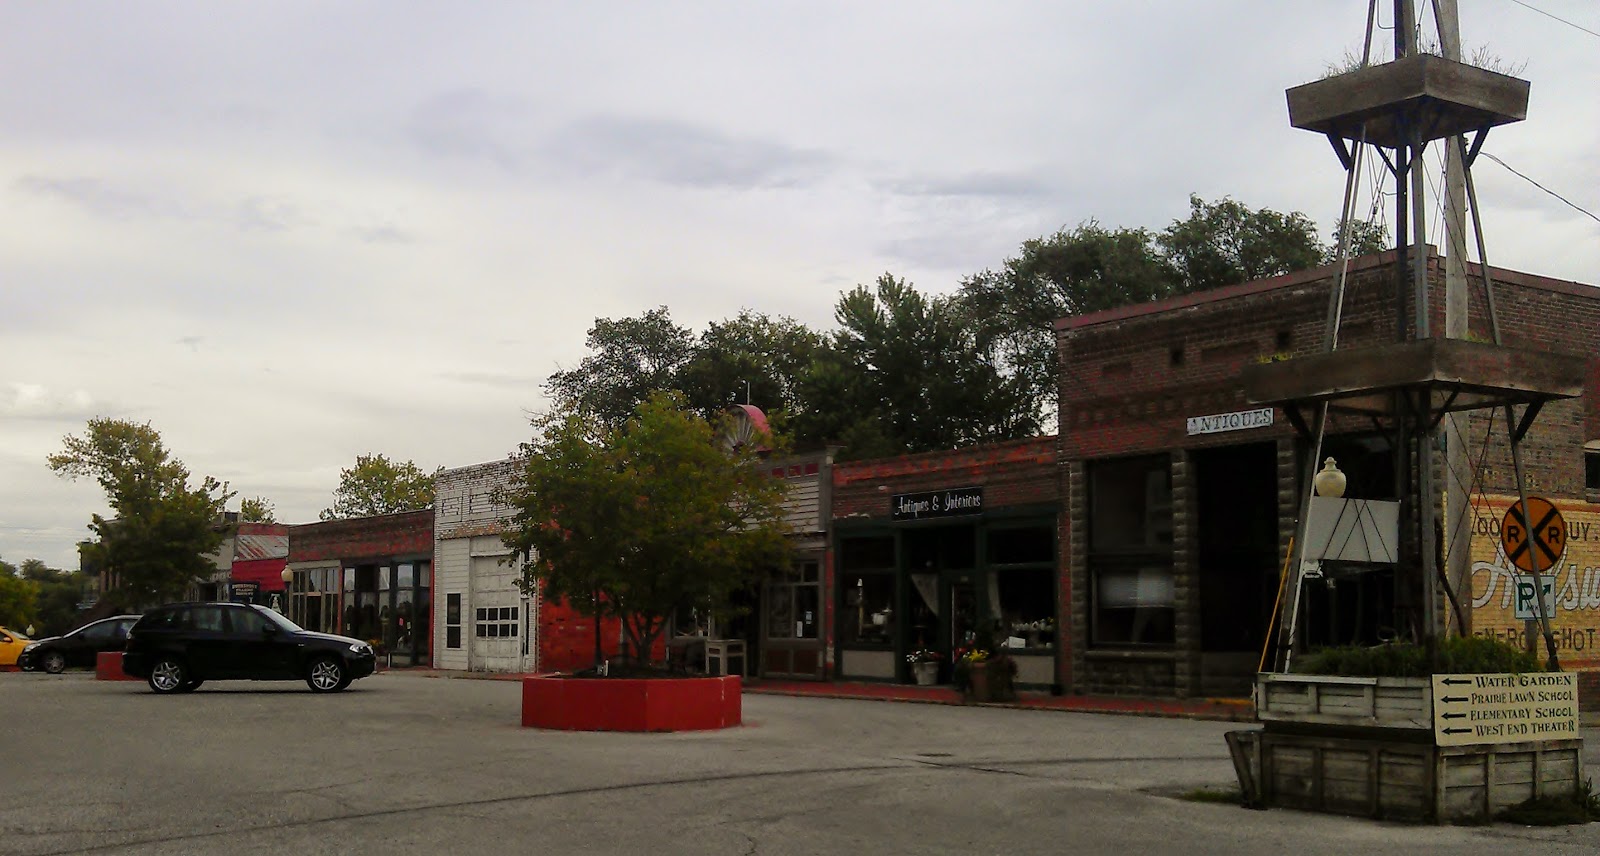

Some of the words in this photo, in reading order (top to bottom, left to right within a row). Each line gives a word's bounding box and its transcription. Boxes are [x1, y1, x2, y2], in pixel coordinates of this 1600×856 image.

[1188, 409, 1271, 432] ANTIQUES
[895, 497, 929, 518] Antiques
[932, 495, 939, 511] &
[944, 492, 980, 511] Interiors
[1507, 526, 1520, 543] R
[1548, 526, 1560, 544] R
[1475, 676, 1515, 688] WATER
[1520, 675, 1572, 687] GARDEN
[1471, 692, 1507, 705] PRAIRIE
[1509, 691, 1535, 703] LAWN
[1538, 690, 1574, 702] SCHOOL
[1470, 708, 1531, 721] ELEMENTARY
[1535, 707, 1574, 718] SCHOOL
[1476, 723, 1504, 737] WEST
[1507, 723, 1528, 735] END
[1531, 720, 1575, 733] THEATER
